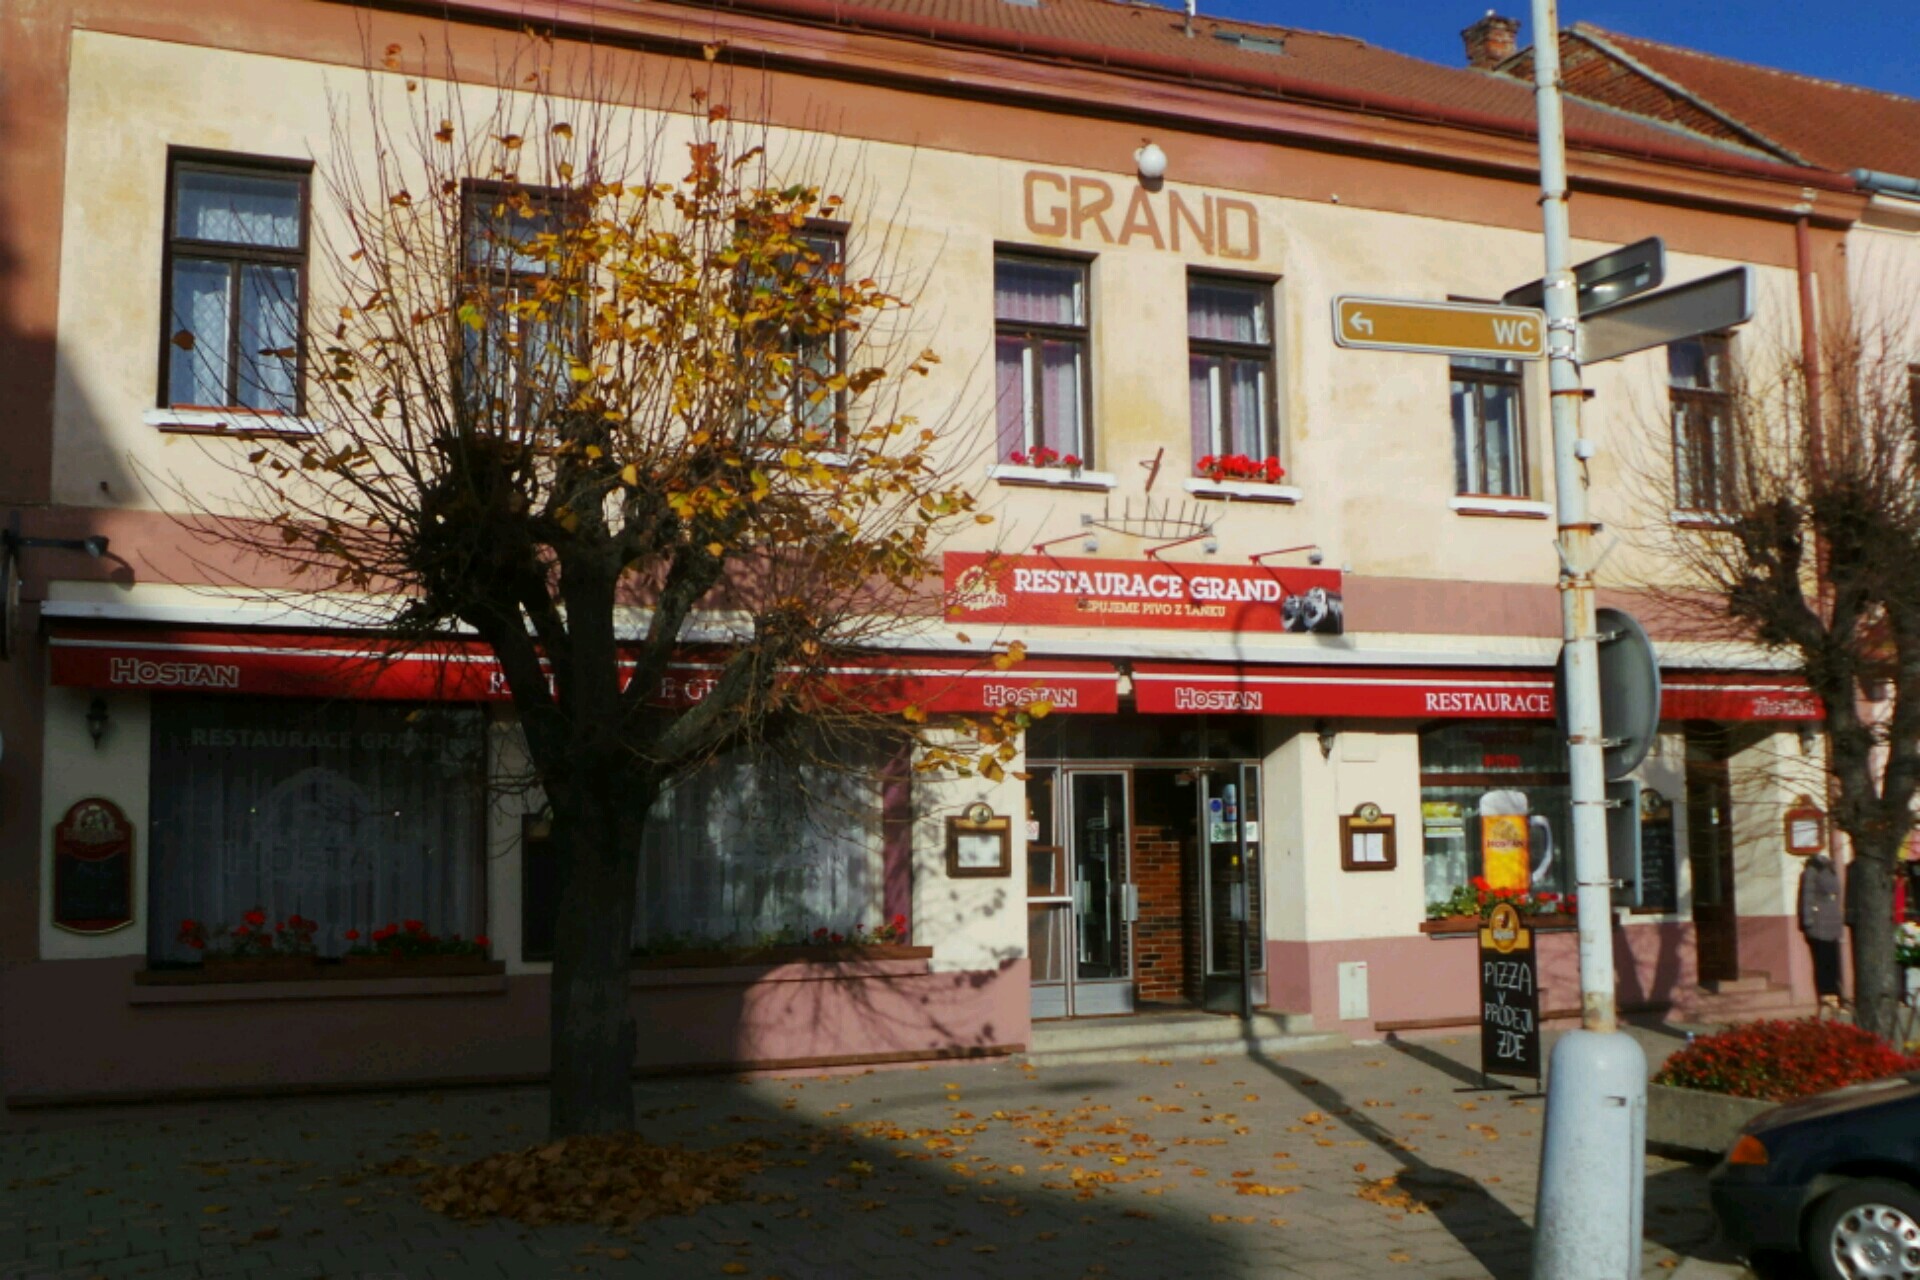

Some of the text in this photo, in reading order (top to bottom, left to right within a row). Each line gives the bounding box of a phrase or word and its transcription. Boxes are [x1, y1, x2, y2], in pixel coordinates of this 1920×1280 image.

[1022, 168, 1260, 262] GRAND
[1491, 317, 1536, 349] WC
[1013, 567, 1281, 603] RESTAURACE GRAND
[1077, 600, 1226, 618] EPUJEME PIVO Z TANKU
[109, 656, 240, 689] HOSTAN
[983, 684, 1078, 708] HOSTAN
[1175, 686, 1263, 711] HOSTAN
[1424, 691, 1551, 714] RESTAURACE
[191, 727, 353, 750] RESTAURACE
[1484, 961, 1533, 996] PIZZA
[1496, 1028, 1527, 1062] ZDE
